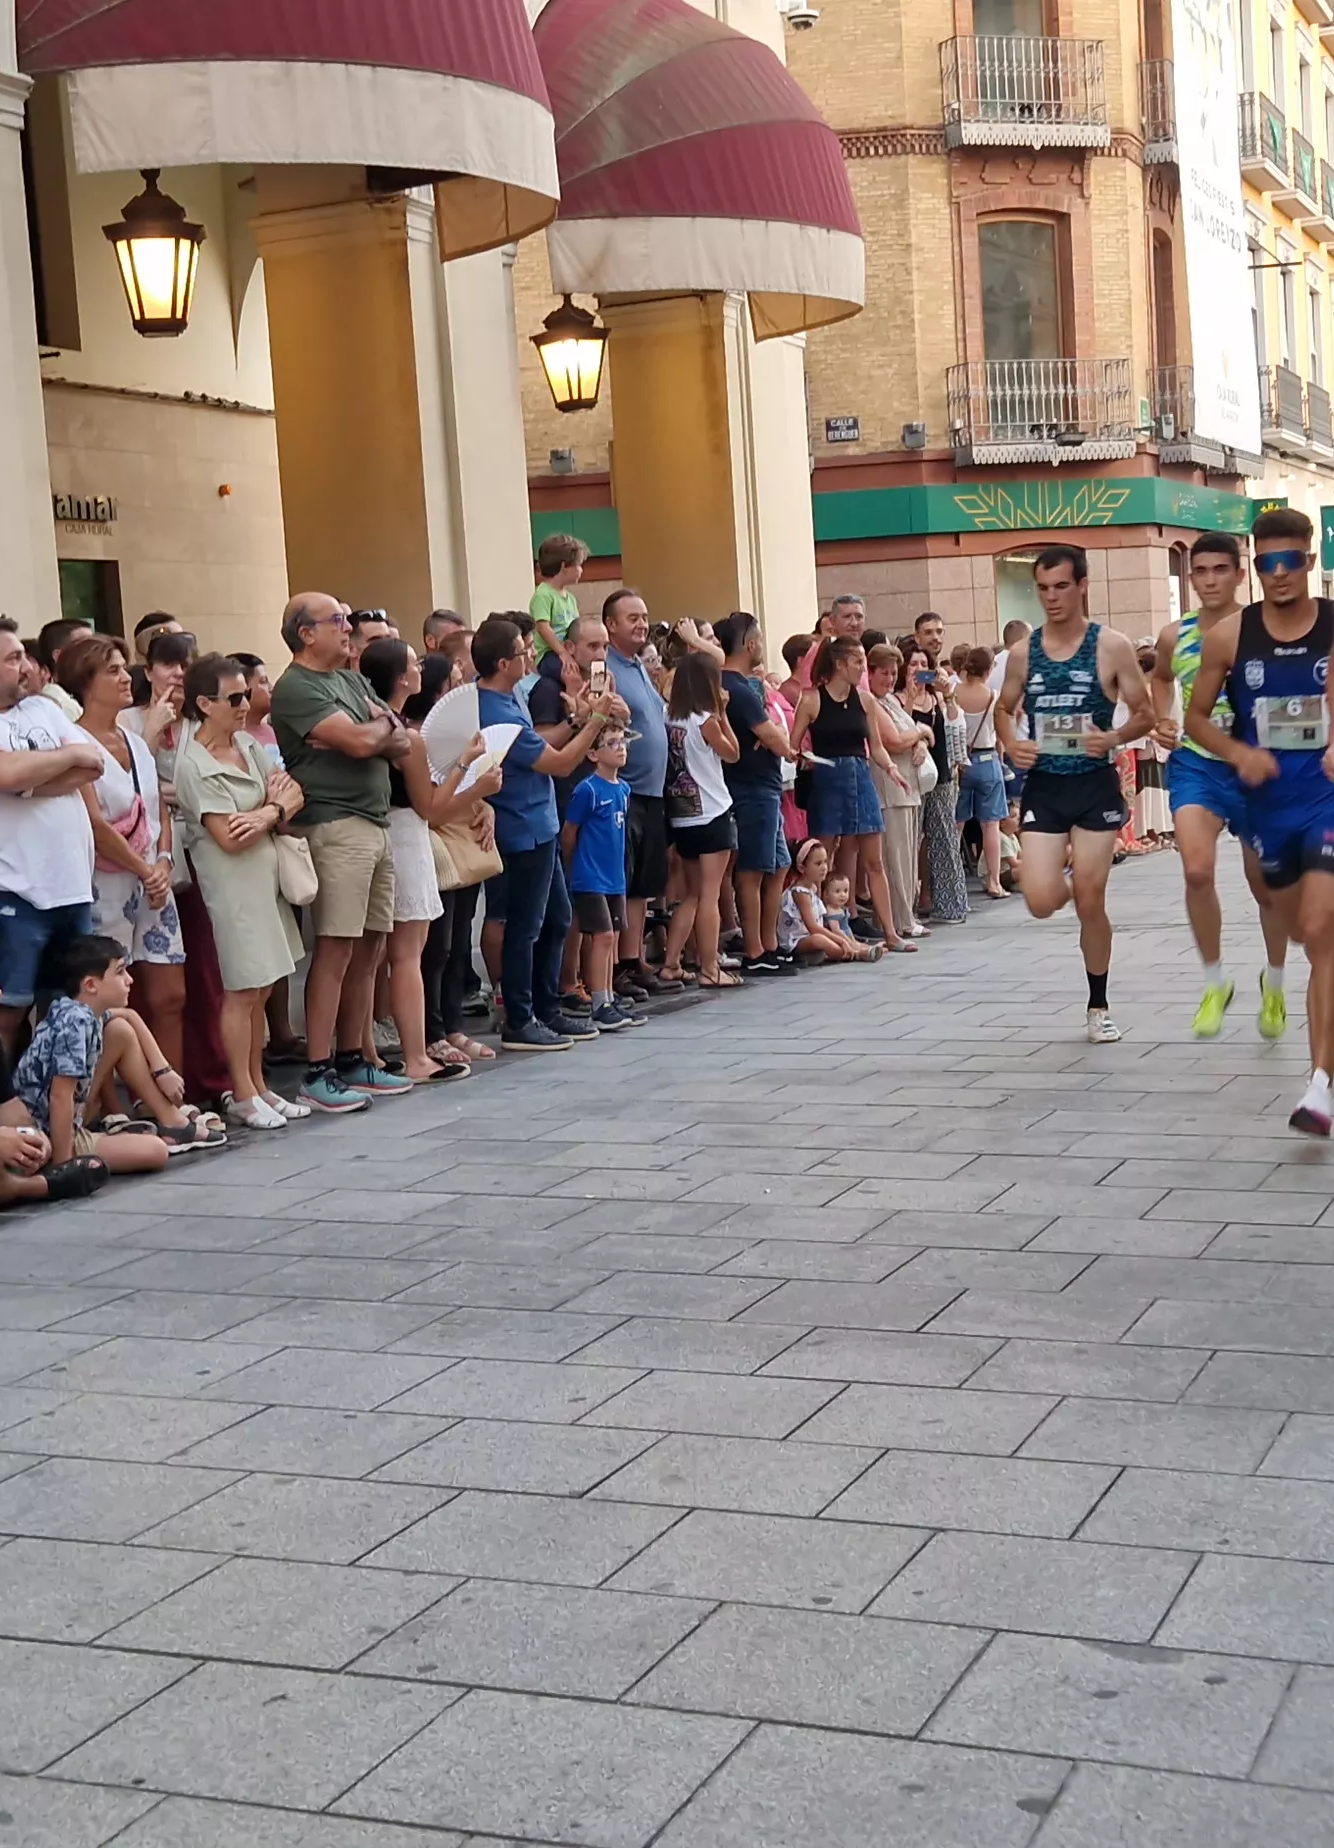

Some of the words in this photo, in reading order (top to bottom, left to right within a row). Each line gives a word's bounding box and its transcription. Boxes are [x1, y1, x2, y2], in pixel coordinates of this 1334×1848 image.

[830, 418, 855, 428] CALLE
[1287, 699, 1302, 716] 6
[1050, 715, 1074, 729] 13
